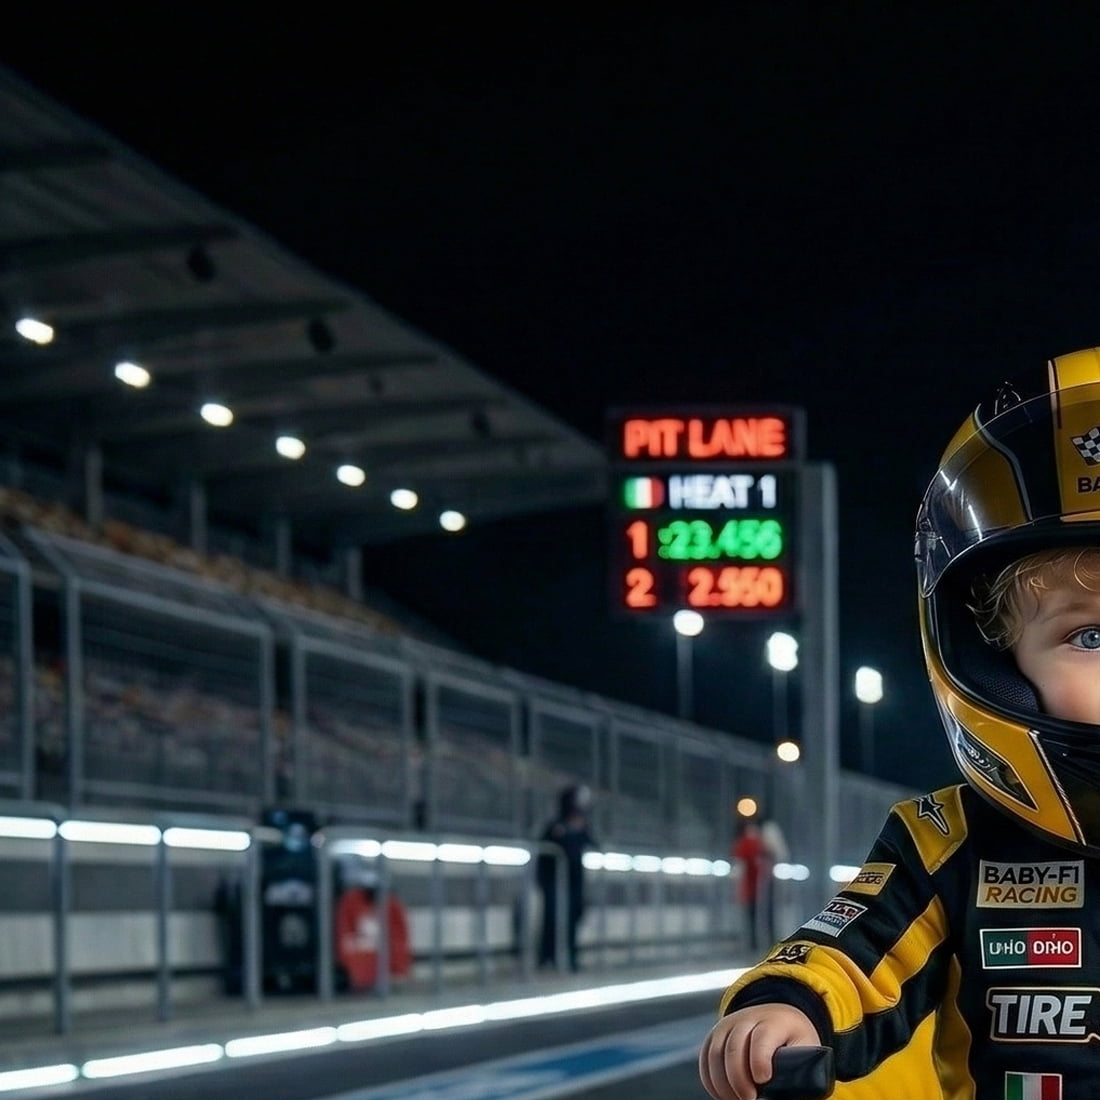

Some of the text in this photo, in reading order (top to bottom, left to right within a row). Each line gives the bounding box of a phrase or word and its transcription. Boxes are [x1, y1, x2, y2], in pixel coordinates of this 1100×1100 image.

[624, 418, 785, 457] PIT LANE
[668, 474, 777, 509] HEAT 1
[626, 521, 648, 559] 1
[626, 567, 656, 608] 2
[985, 886, 1077, 904] RACING
[991, 994, 1093, 1036] TIRE
